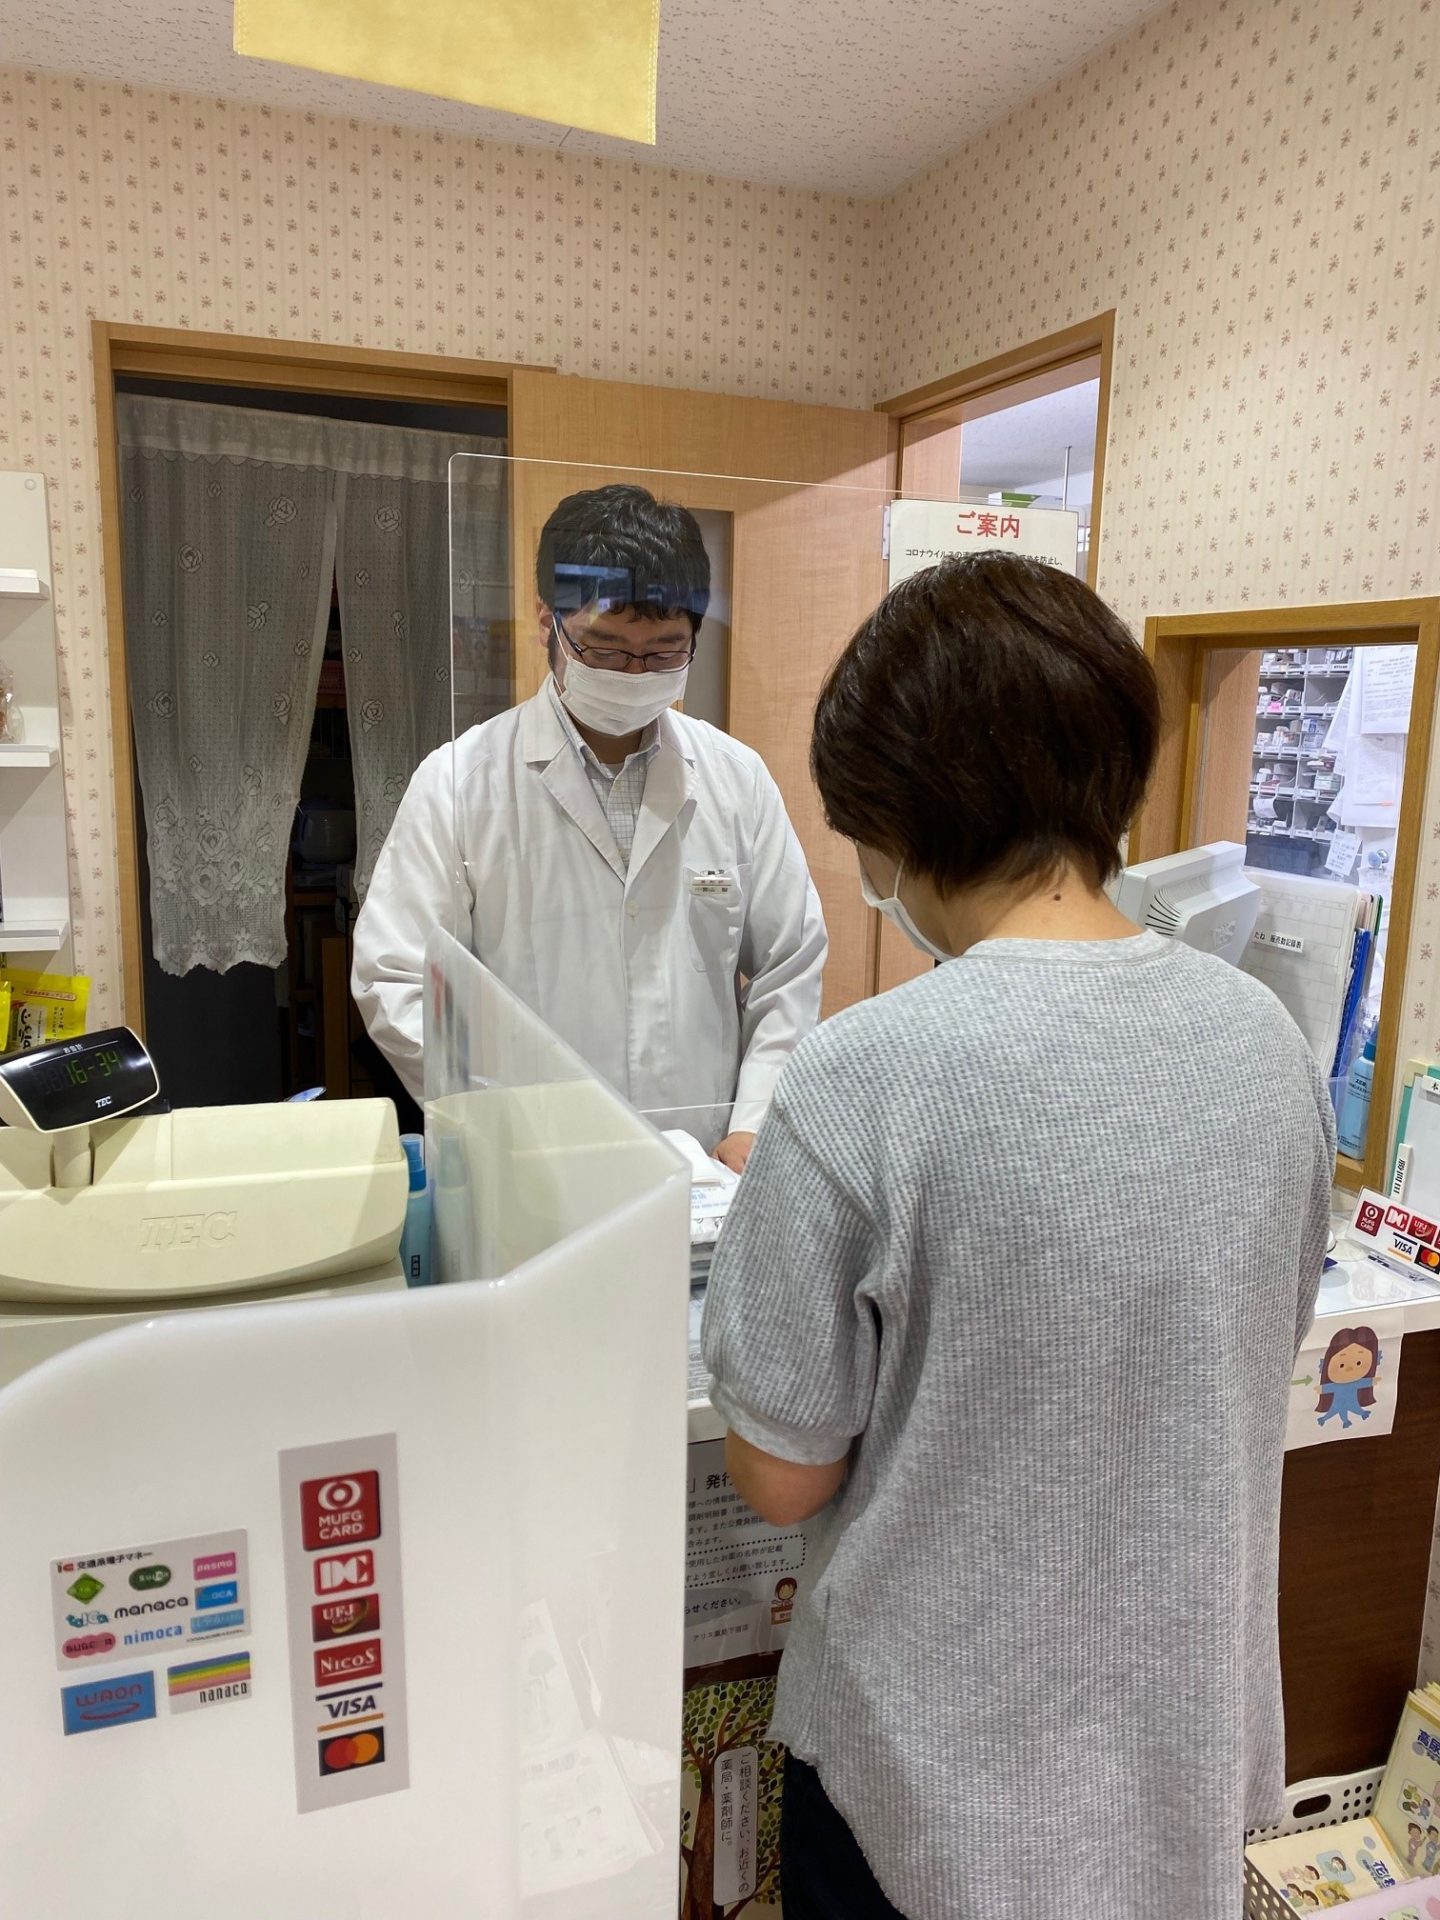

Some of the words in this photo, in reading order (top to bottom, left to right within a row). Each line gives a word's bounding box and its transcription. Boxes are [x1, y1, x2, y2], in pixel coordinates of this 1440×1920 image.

[957, 511, 1021, 539] ご案内
[95, 1096, 112, 1109] TEC
[139, 1210, 238, 1249] TEC
[1394, 1238, 1413, 1255] VISA
[318, 1510, 363, 1528] MUFG
[319, 1522, 364, 1540] CARD
[320, 1555, 369, 1590] DC
[114, 1596, 189, 1619] manaca
[322, 1604, 355, 1621] UFJ
[123, 1624, 183, 1646] nimoca
[75, 1683, 144, 1708] WAON
[199, 1682, 248, 1704] nanaco
[325, 1694, 376, 1719] VISA
